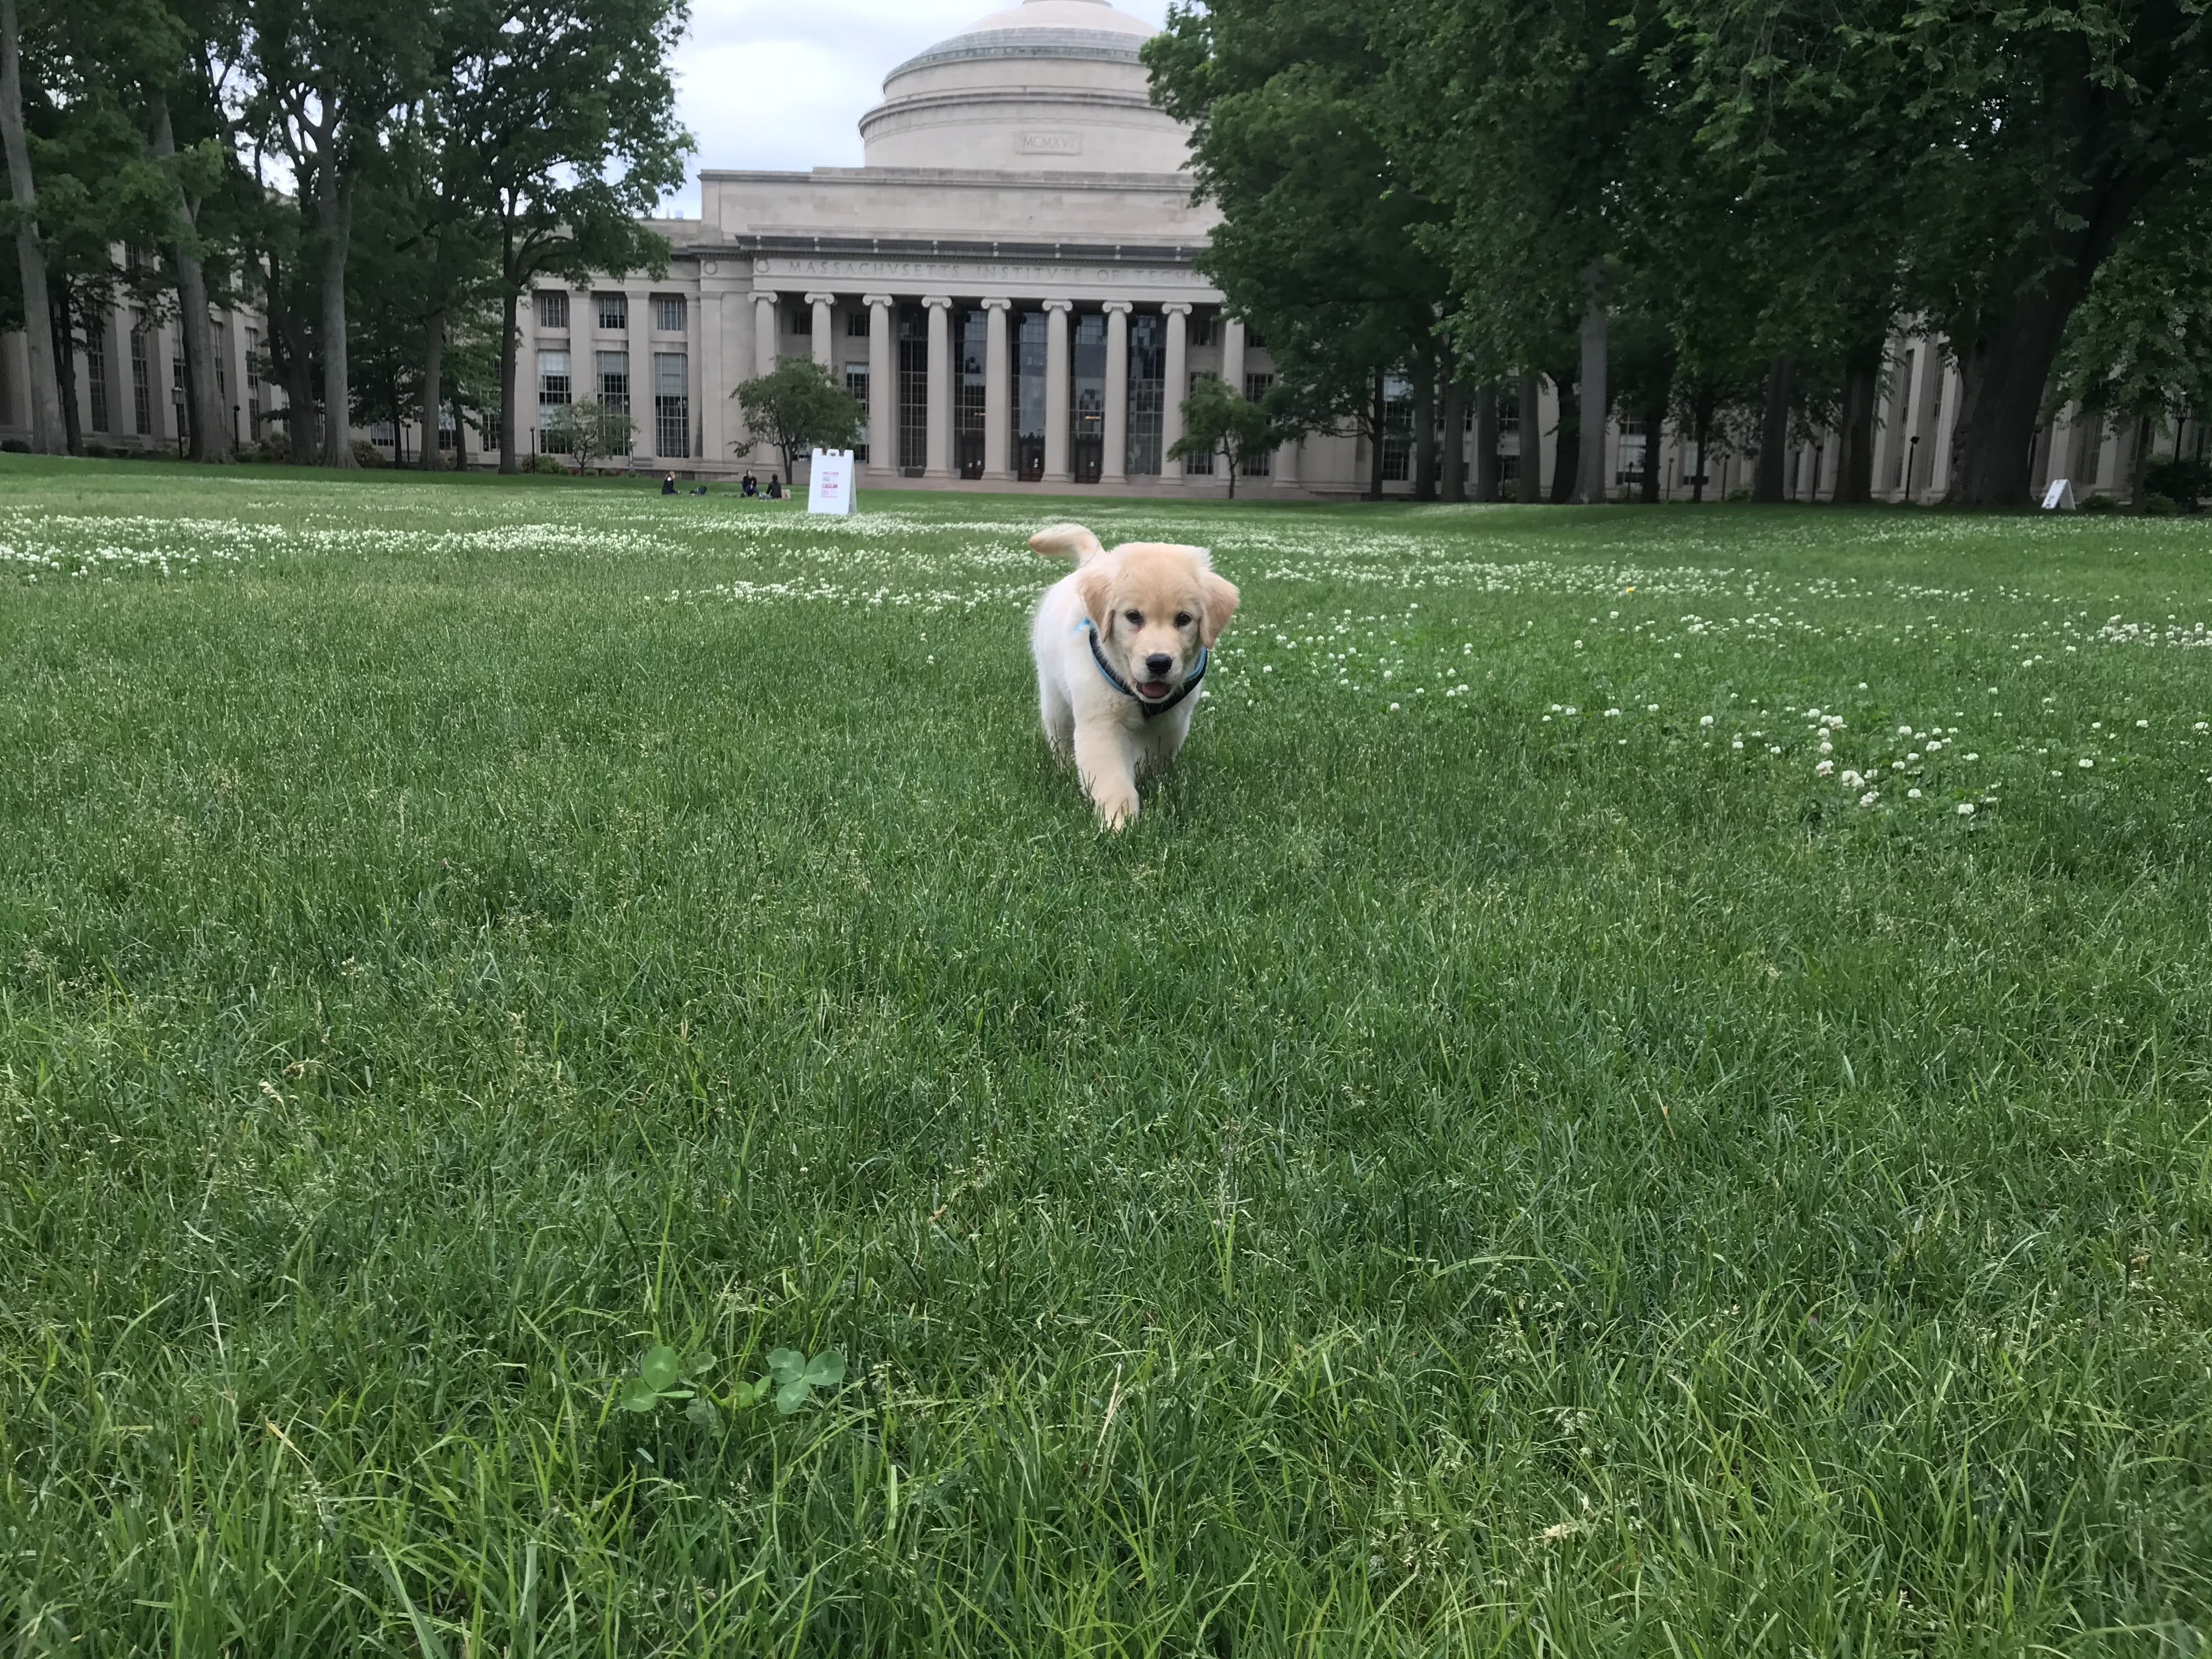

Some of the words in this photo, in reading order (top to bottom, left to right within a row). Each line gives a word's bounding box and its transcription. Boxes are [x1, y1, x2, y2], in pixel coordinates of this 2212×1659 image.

[1022, 136, 1074, 148] MCMXVI
[789, 261, 960, 277] MASSACHVSETTS
[977, 266, 1081, 281] INSTITVTE
[1097, 269, 1120, 281] OF
[1133, 269, 1205, 284] TECHN
